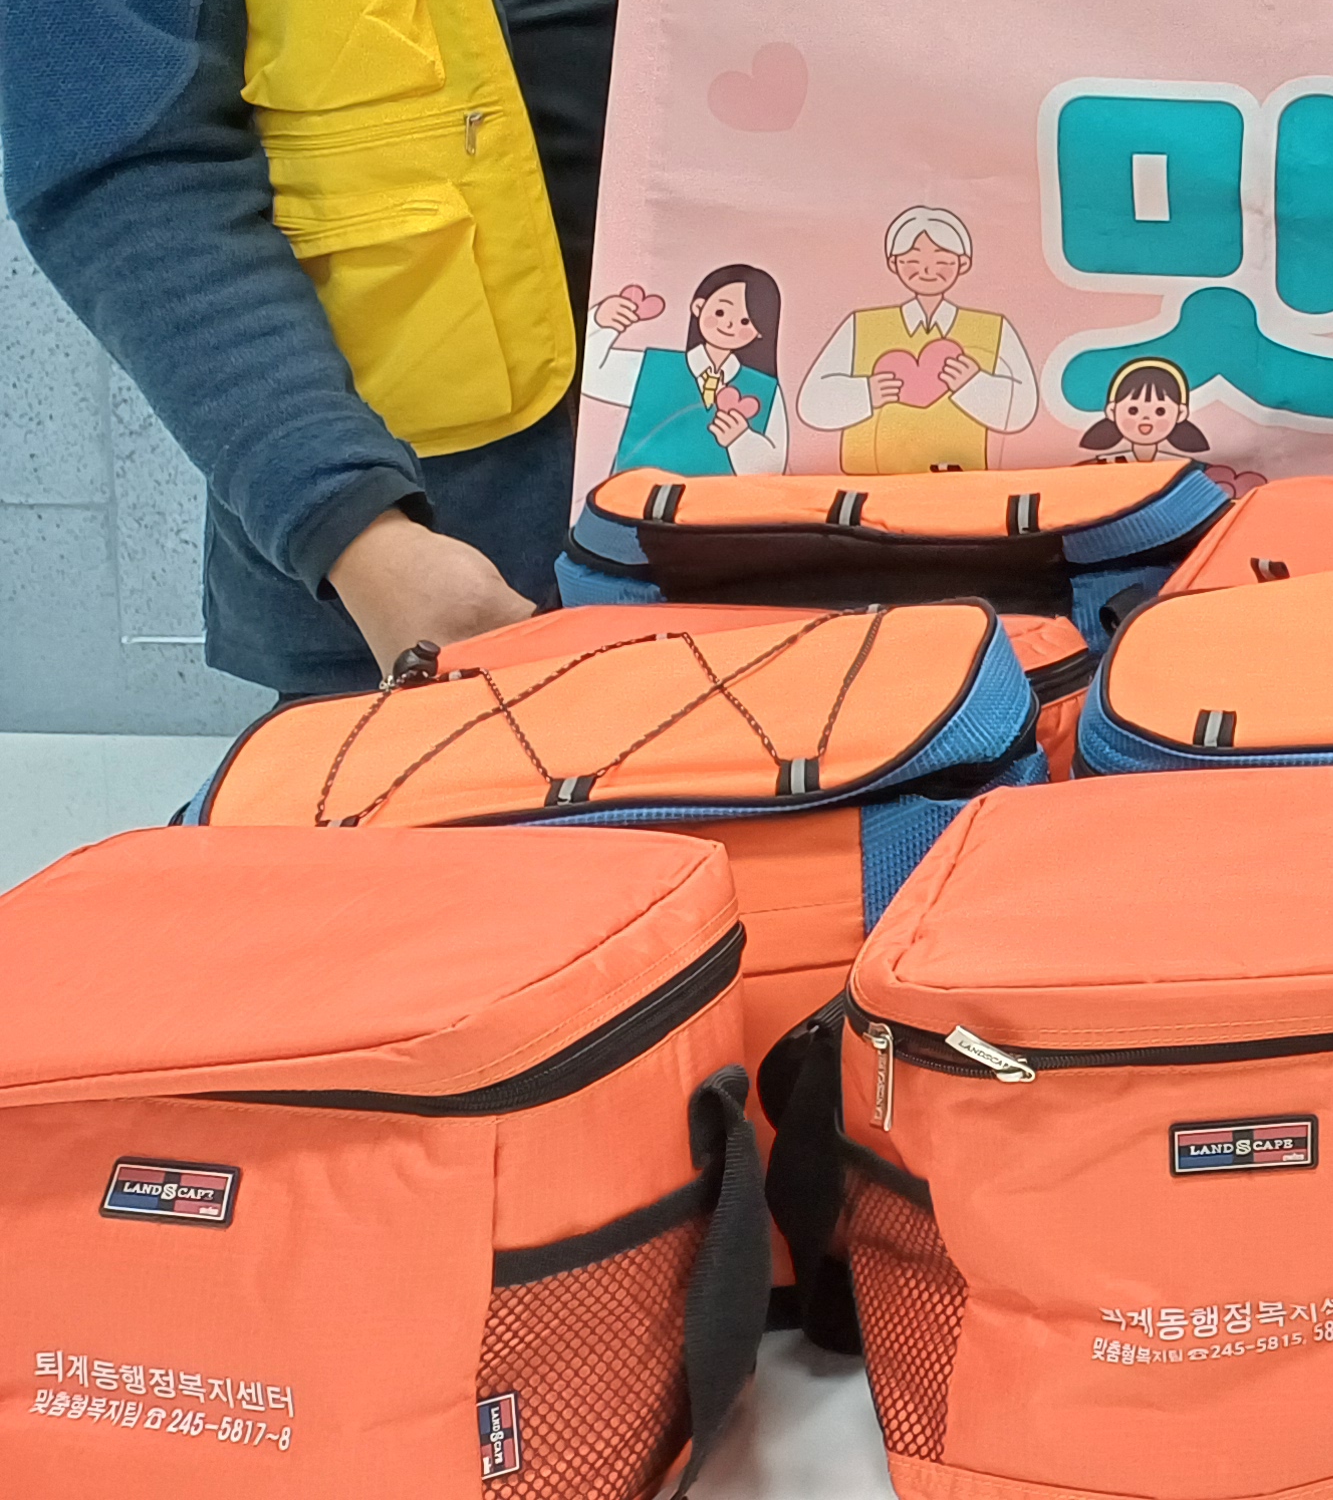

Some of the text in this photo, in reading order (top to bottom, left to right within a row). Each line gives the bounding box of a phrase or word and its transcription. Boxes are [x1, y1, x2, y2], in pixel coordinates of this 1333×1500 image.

[1189, 1138, 1294, 1156] LANDSCAPE
[33, 1349, 295, 1419] 퇴계동행정복지센터
[28, 1387, 292, 1452] 맞춤형복지팀 245-5817~8
